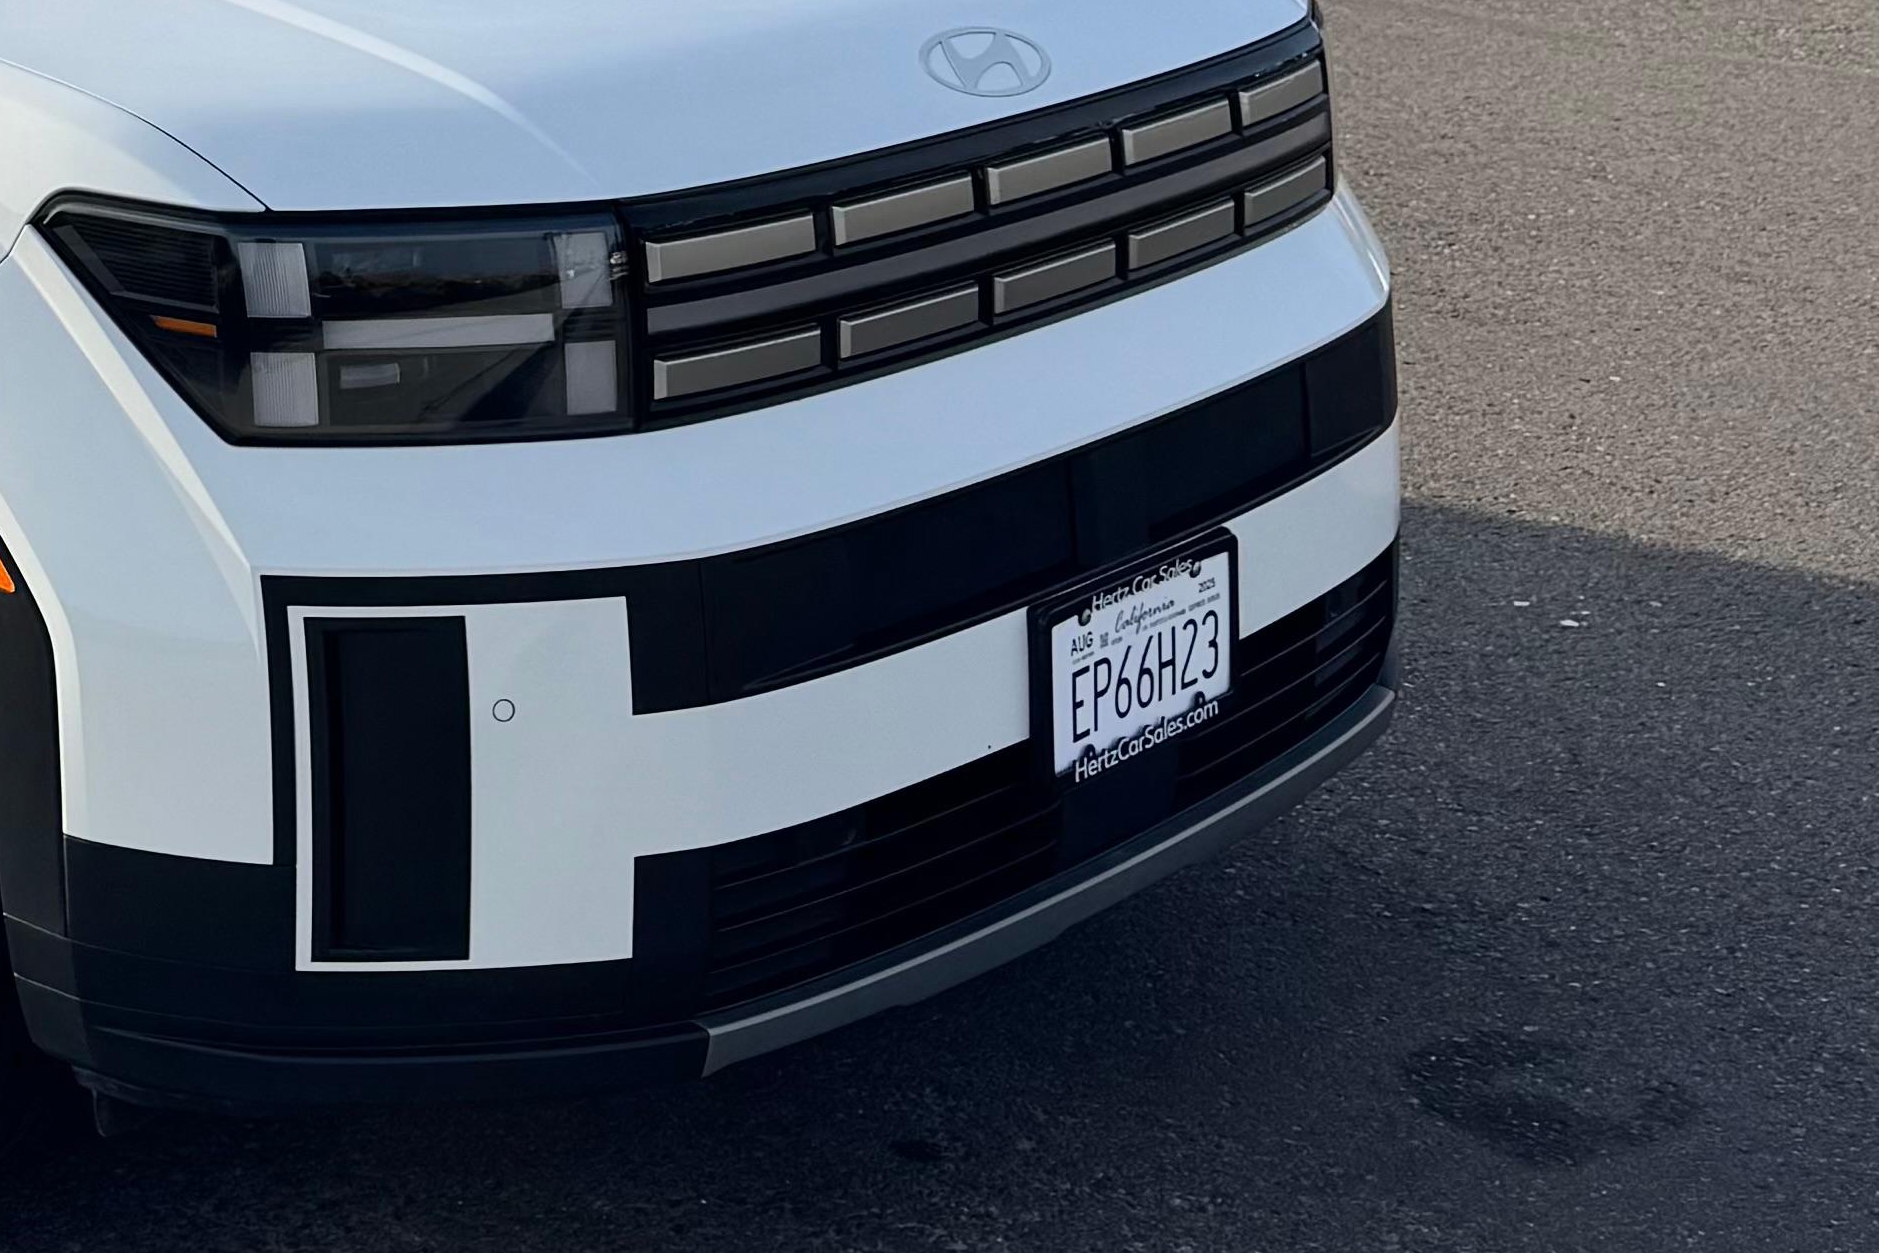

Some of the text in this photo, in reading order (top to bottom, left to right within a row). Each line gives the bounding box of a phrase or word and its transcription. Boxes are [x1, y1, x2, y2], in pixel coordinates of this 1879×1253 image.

[1092, 587, 1129, 611] Hertz
[1132, 575, 1159, 594] Car
[1197, 577, 1216, 593] 2025
[1115, 596, 1175, 634] California
[1071, 631, 1094, 656] AUG
[1071, 609, 1220, 744] EP66H23
[1075, 700, 1220, 783] HertzCarSales.com
